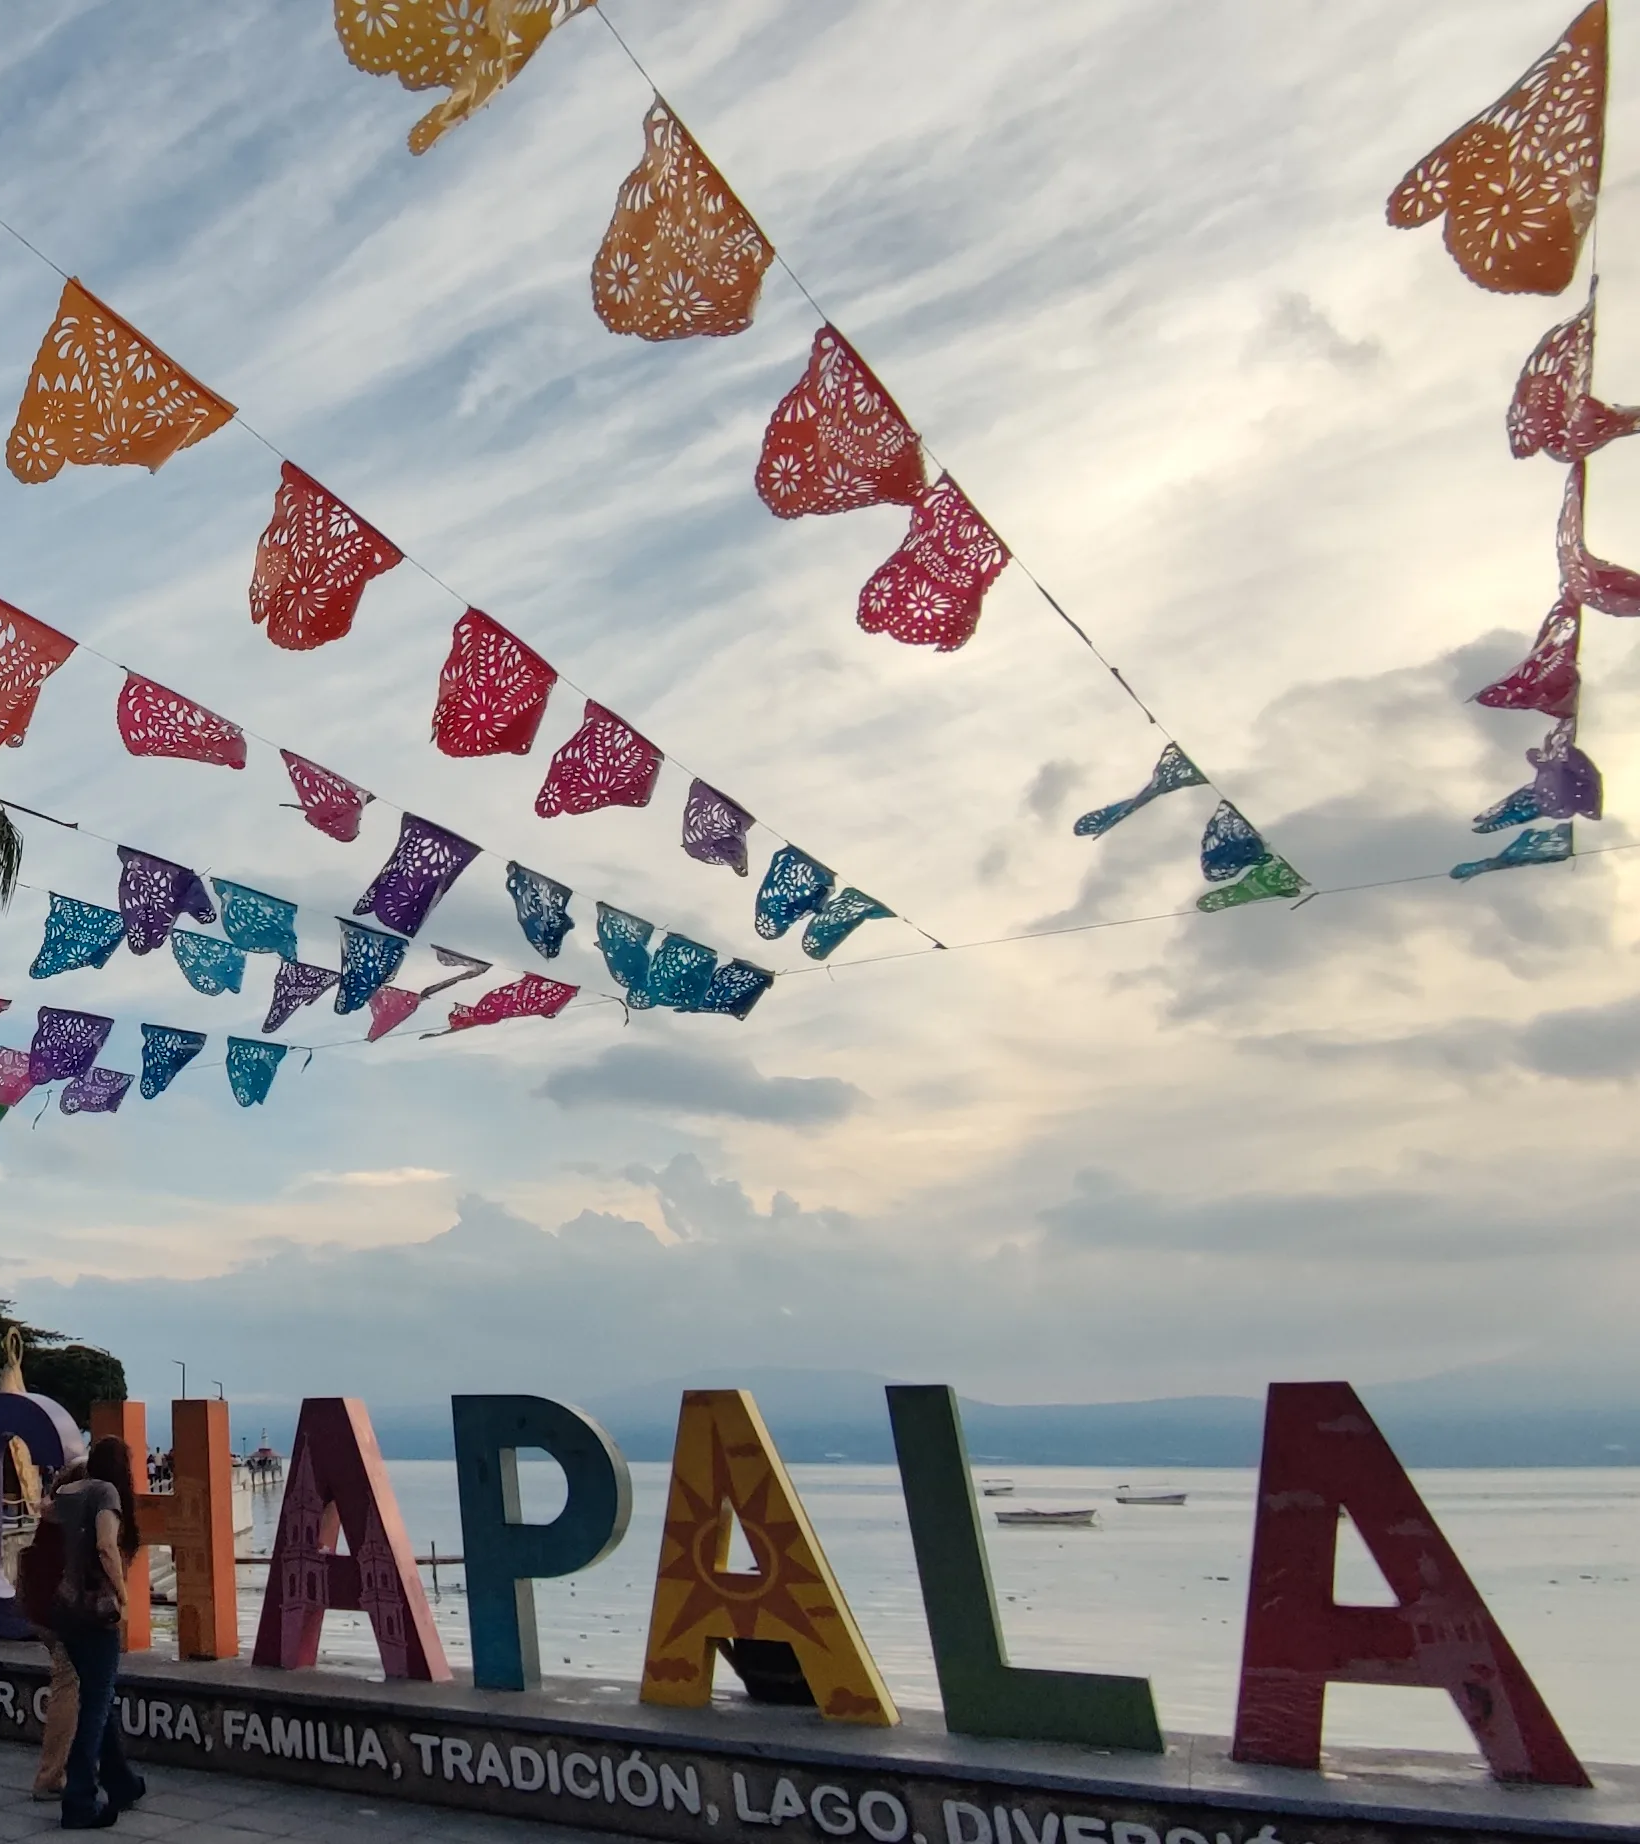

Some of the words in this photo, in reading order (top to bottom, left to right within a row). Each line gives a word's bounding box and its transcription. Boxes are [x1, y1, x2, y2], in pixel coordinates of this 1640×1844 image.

[32, 1685, 213, 1753] CURA,
[222, 1709, 403, 1781] FAMILIA,
[409, 1732, 720, 1826] TRADICIÓN,
